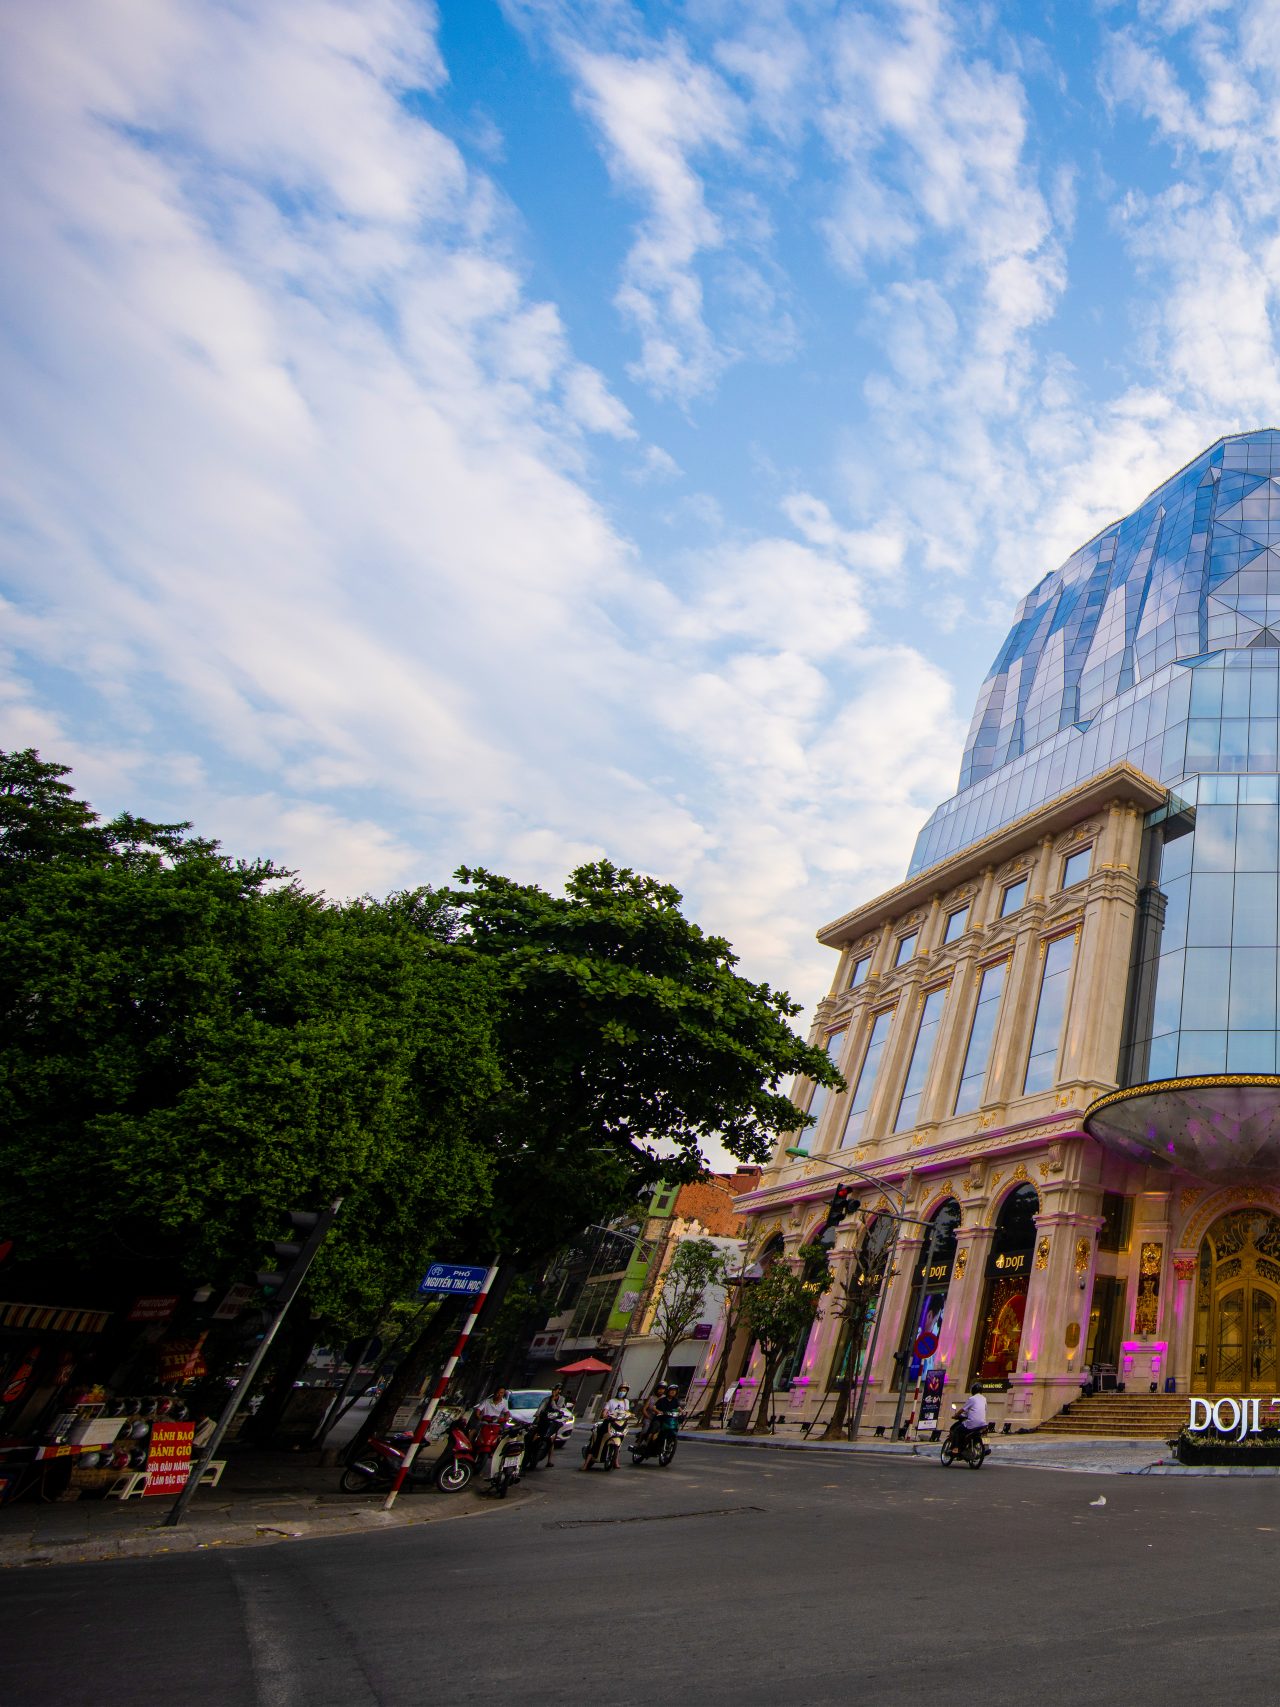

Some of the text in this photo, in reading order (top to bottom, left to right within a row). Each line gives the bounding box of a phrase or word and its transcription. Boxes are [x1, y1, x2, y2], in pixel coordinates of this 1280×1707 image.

[1005, 1255, 1025, 1271] DOJI
[929, 1265, 947, 1280] DOJI
[425, 1276, 453, 1288] NGUYỄN
[452, 1278, 468, 1289] THÁI
[1188, 1397, 1262, 1442] DOJI
[152, 1429, 194, 1441] BÁNH BAO
[149, 1444, 175, 1457] BÁNH
